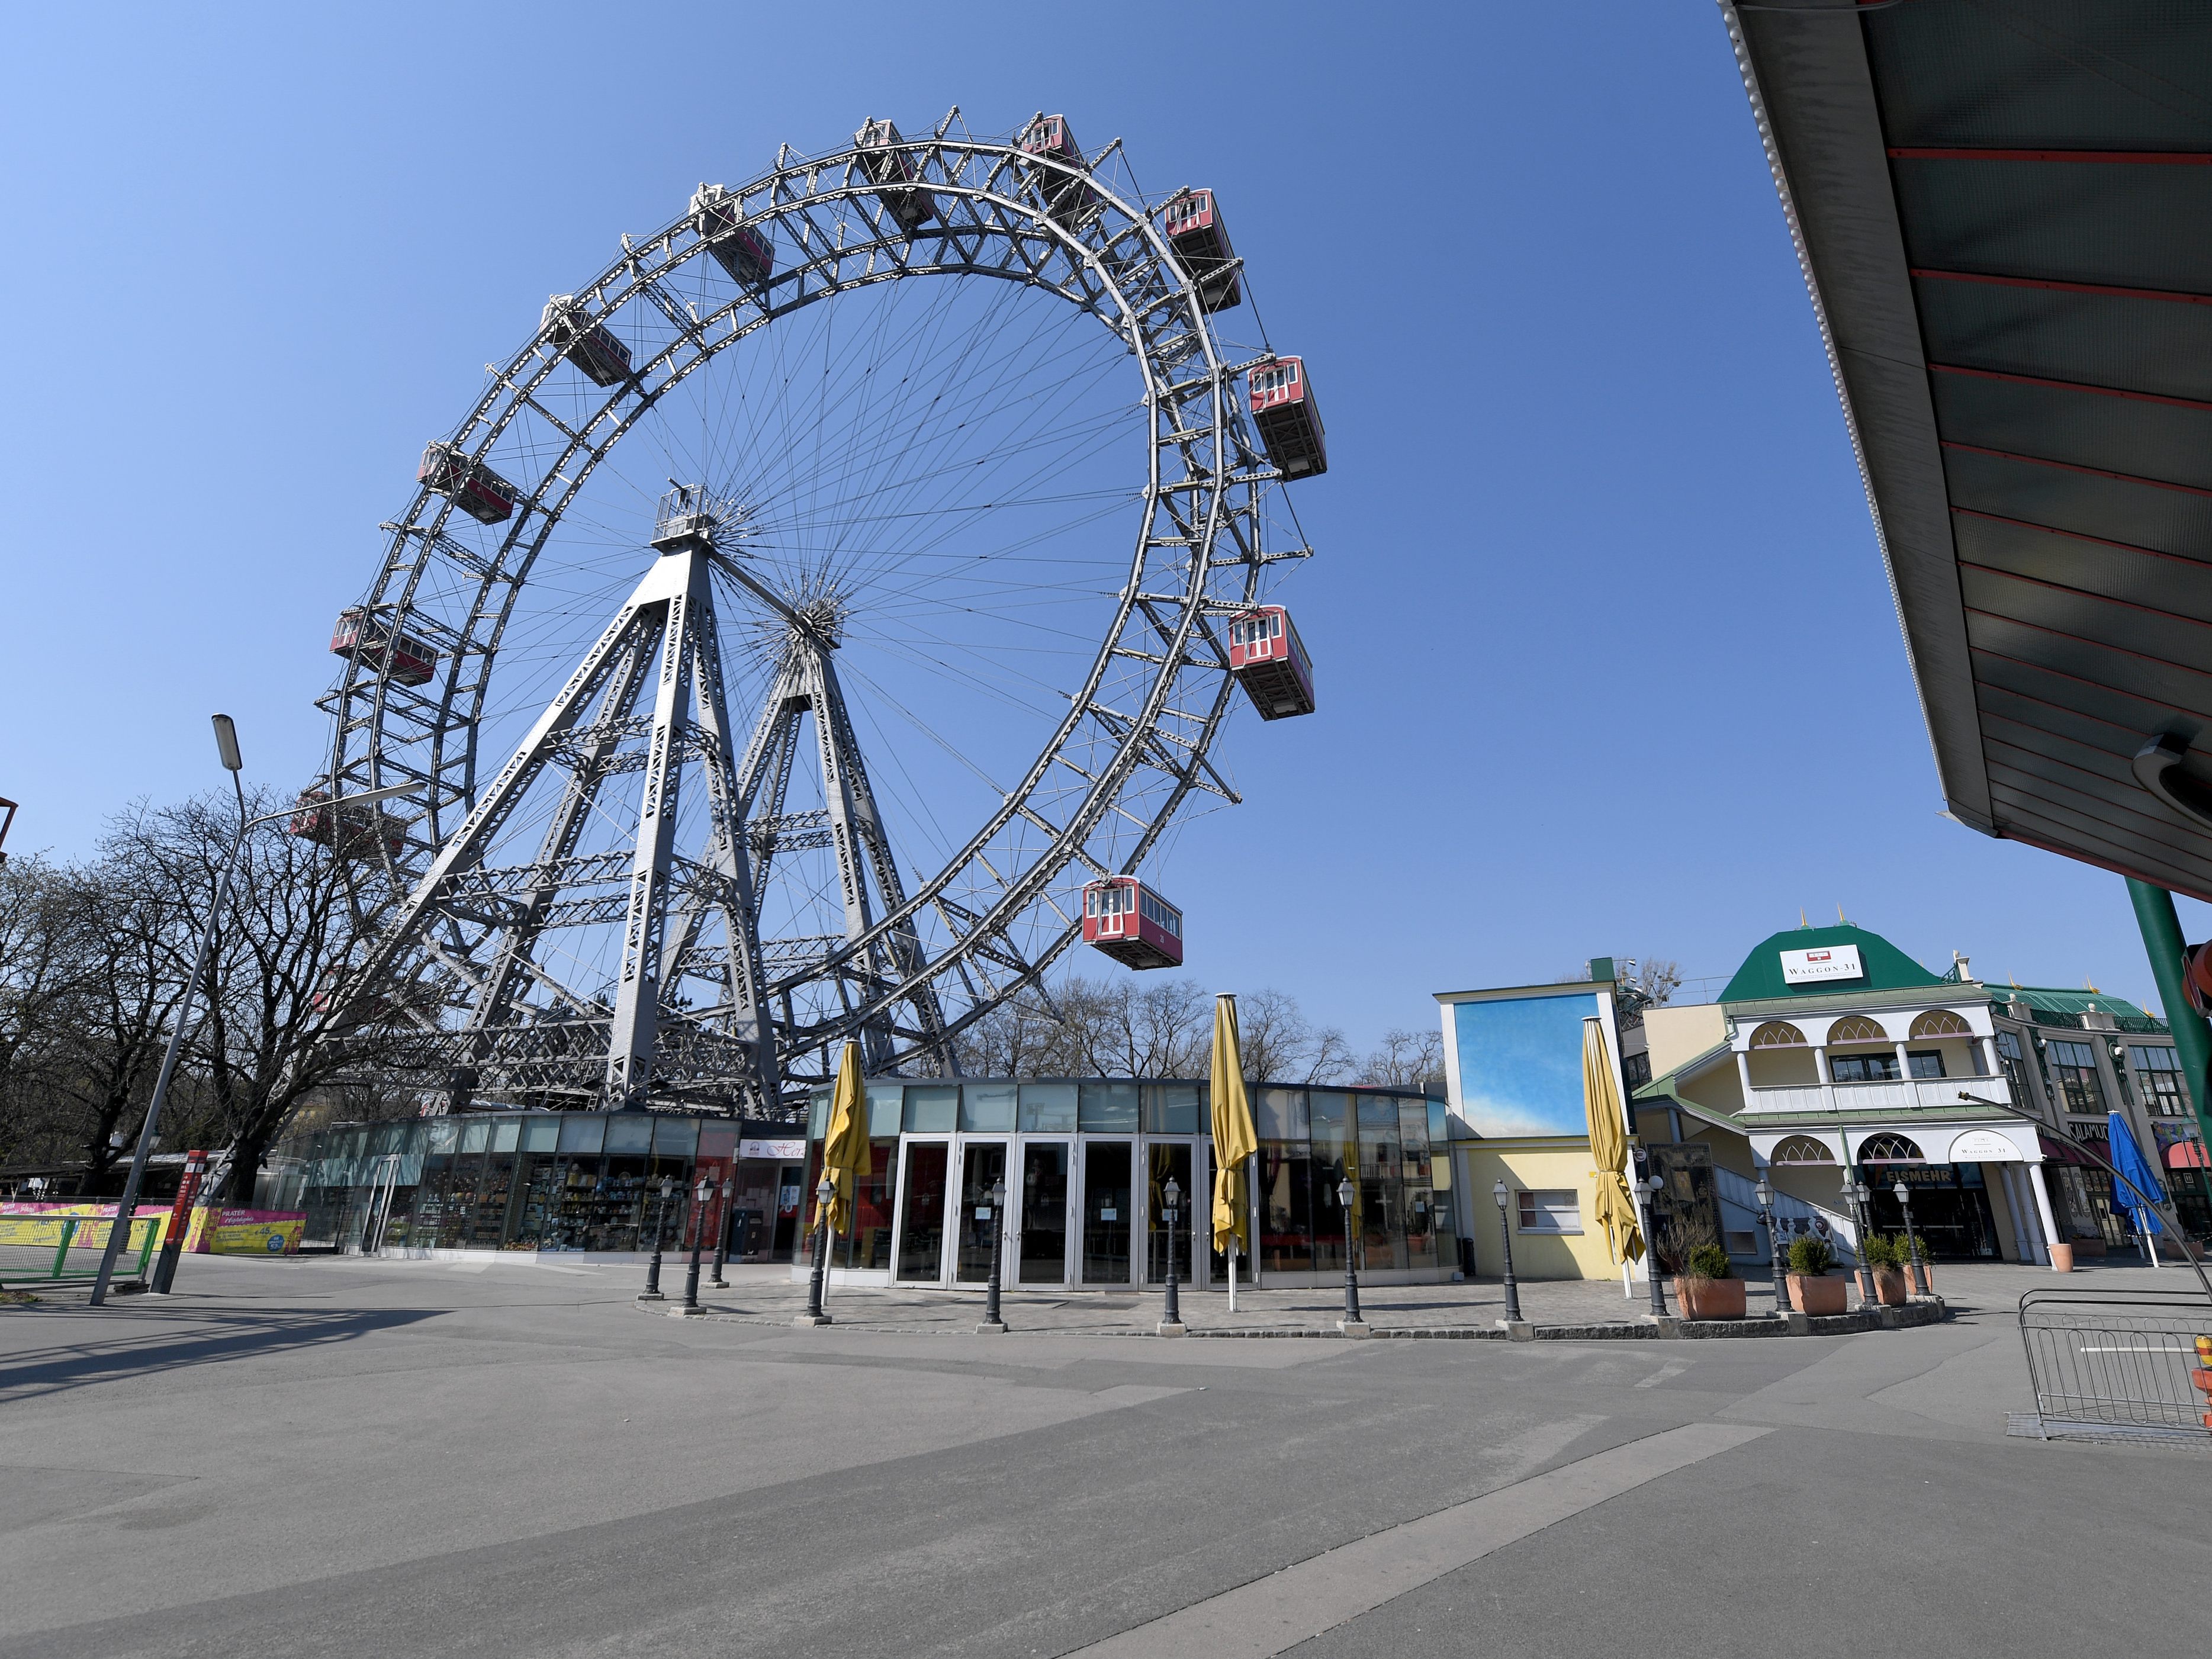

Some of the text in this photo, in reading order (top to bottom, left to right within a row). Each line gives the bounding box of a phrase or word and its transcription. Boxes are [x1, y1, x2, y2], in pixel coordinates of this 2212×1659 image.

[1789, 963, 1856, 975] WAGGON-31
[1886, 1170, 1951, 1182] EISMEHR
[224, 1216, 254, 1224] Highlights
